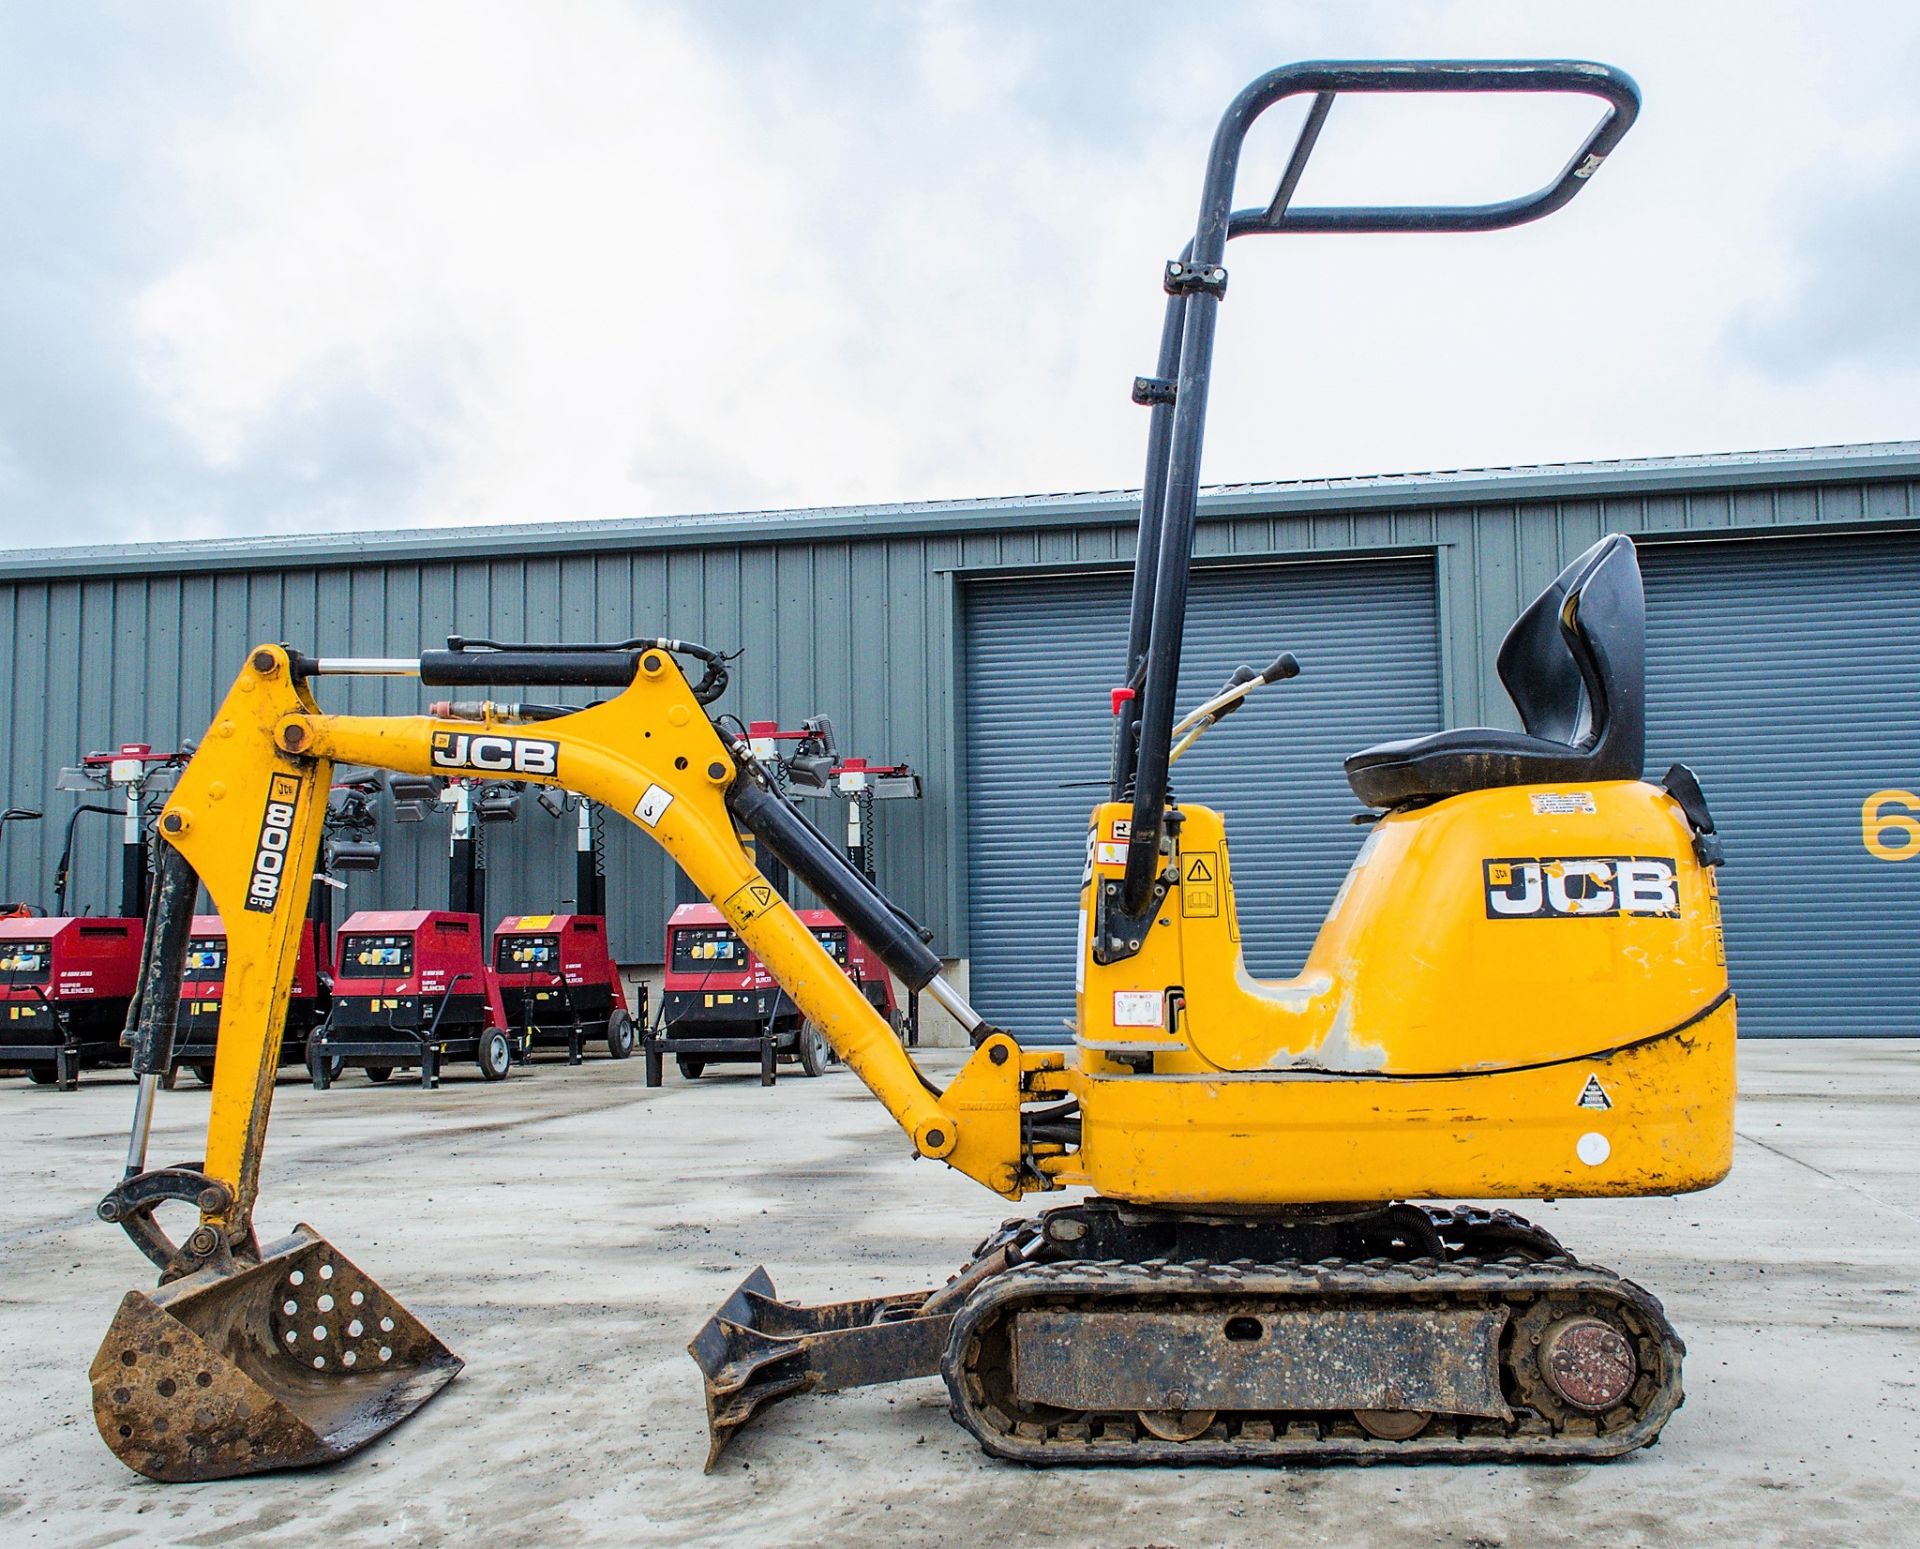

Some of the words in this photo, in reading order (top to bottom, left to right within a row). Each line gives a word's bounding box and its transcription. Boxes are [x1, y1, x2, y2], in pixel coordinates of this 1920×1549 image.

[434, 735, 556, 774] JCB
[250, 803, 294, 898] 8008
[1861, 789, 1920, 862] 6
[249, 897, 273, 908] CTS
[1490, 861, 1676, 914] JCB
